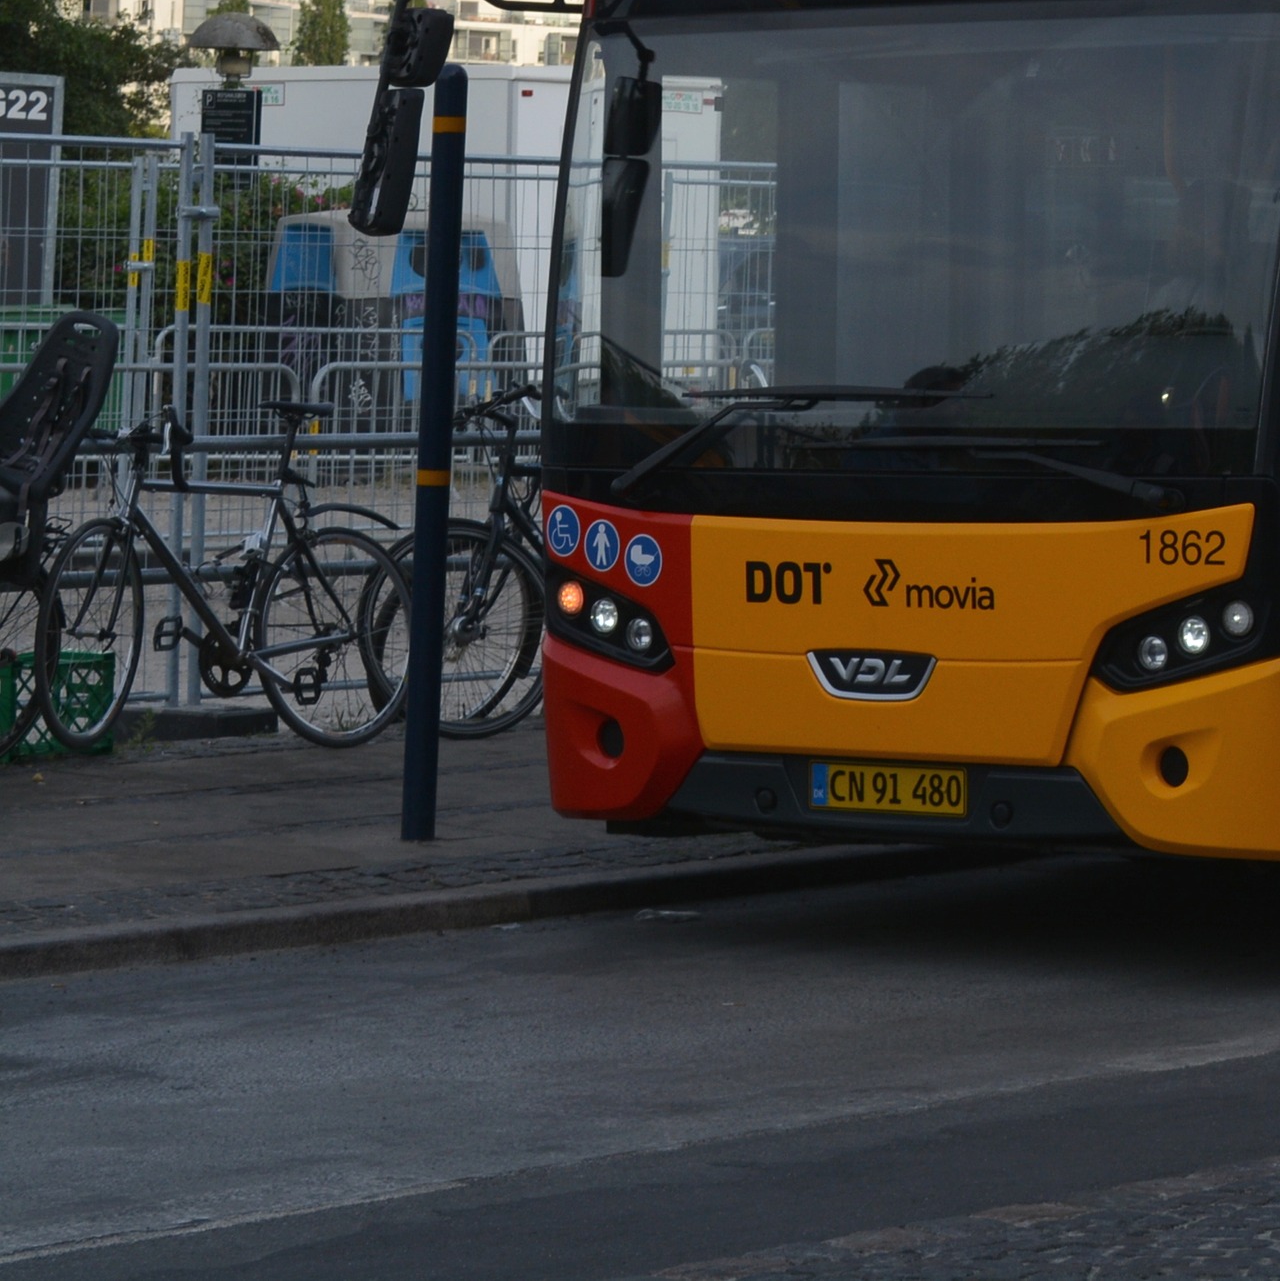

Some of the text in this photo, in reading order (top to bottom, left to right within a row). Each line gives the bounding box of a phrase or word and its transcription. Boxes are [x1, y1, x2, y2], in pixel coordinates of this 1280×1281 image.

[1138, 530, 1226, 565] 1862
[745, 560, 832, 606] DOT
[905, 577, 995, 610] movia
[829, 657, 911, 684] VDL
[830, 770, 962, 807] CN 91 480
